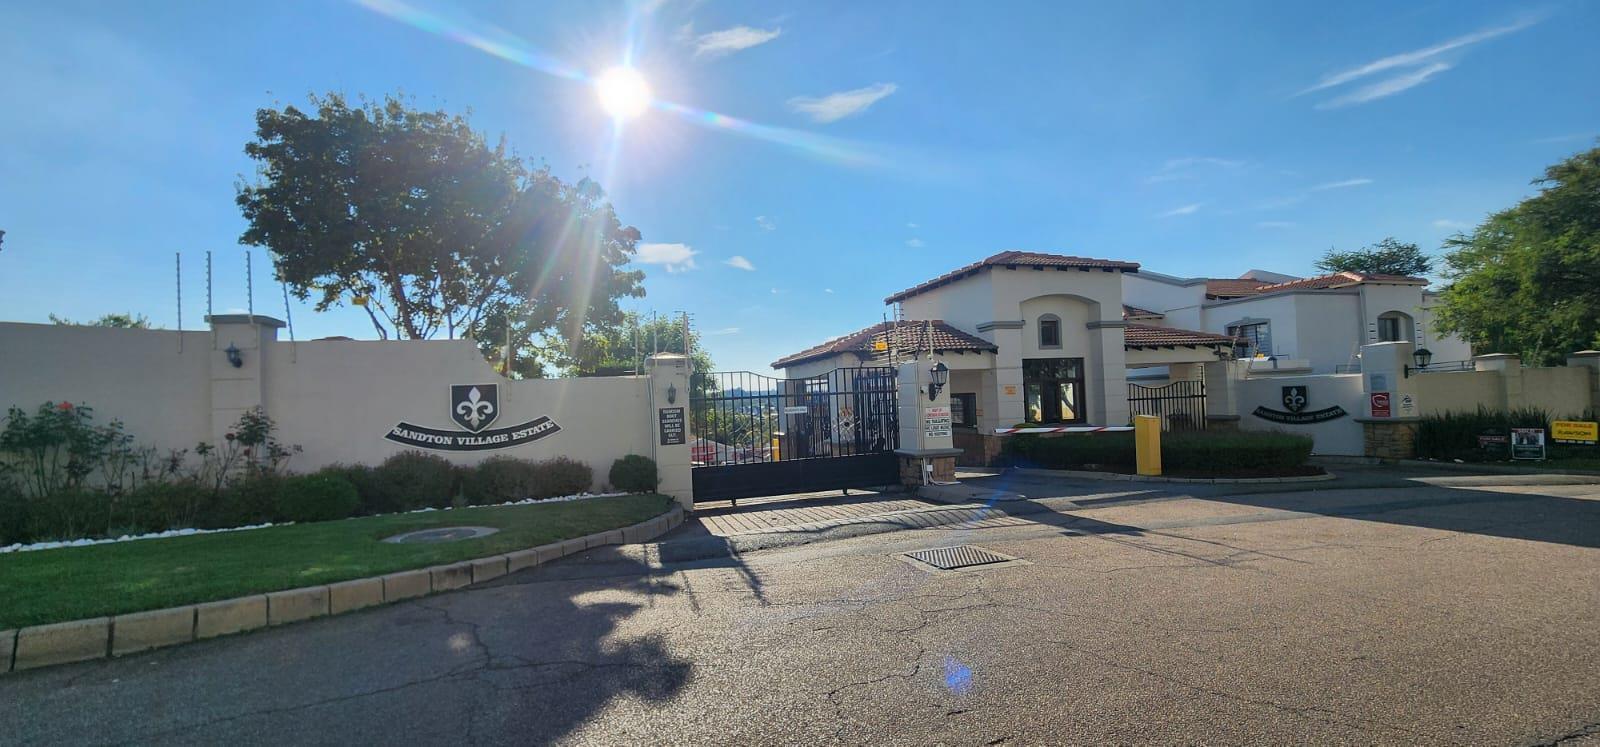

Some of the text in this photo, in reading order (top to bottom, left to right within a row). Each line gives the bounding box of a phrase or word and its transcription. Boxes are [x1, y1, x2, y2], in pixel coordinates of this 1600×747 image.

[391, 420, 555, 446] SANDTON VILLAGE ESTATE
